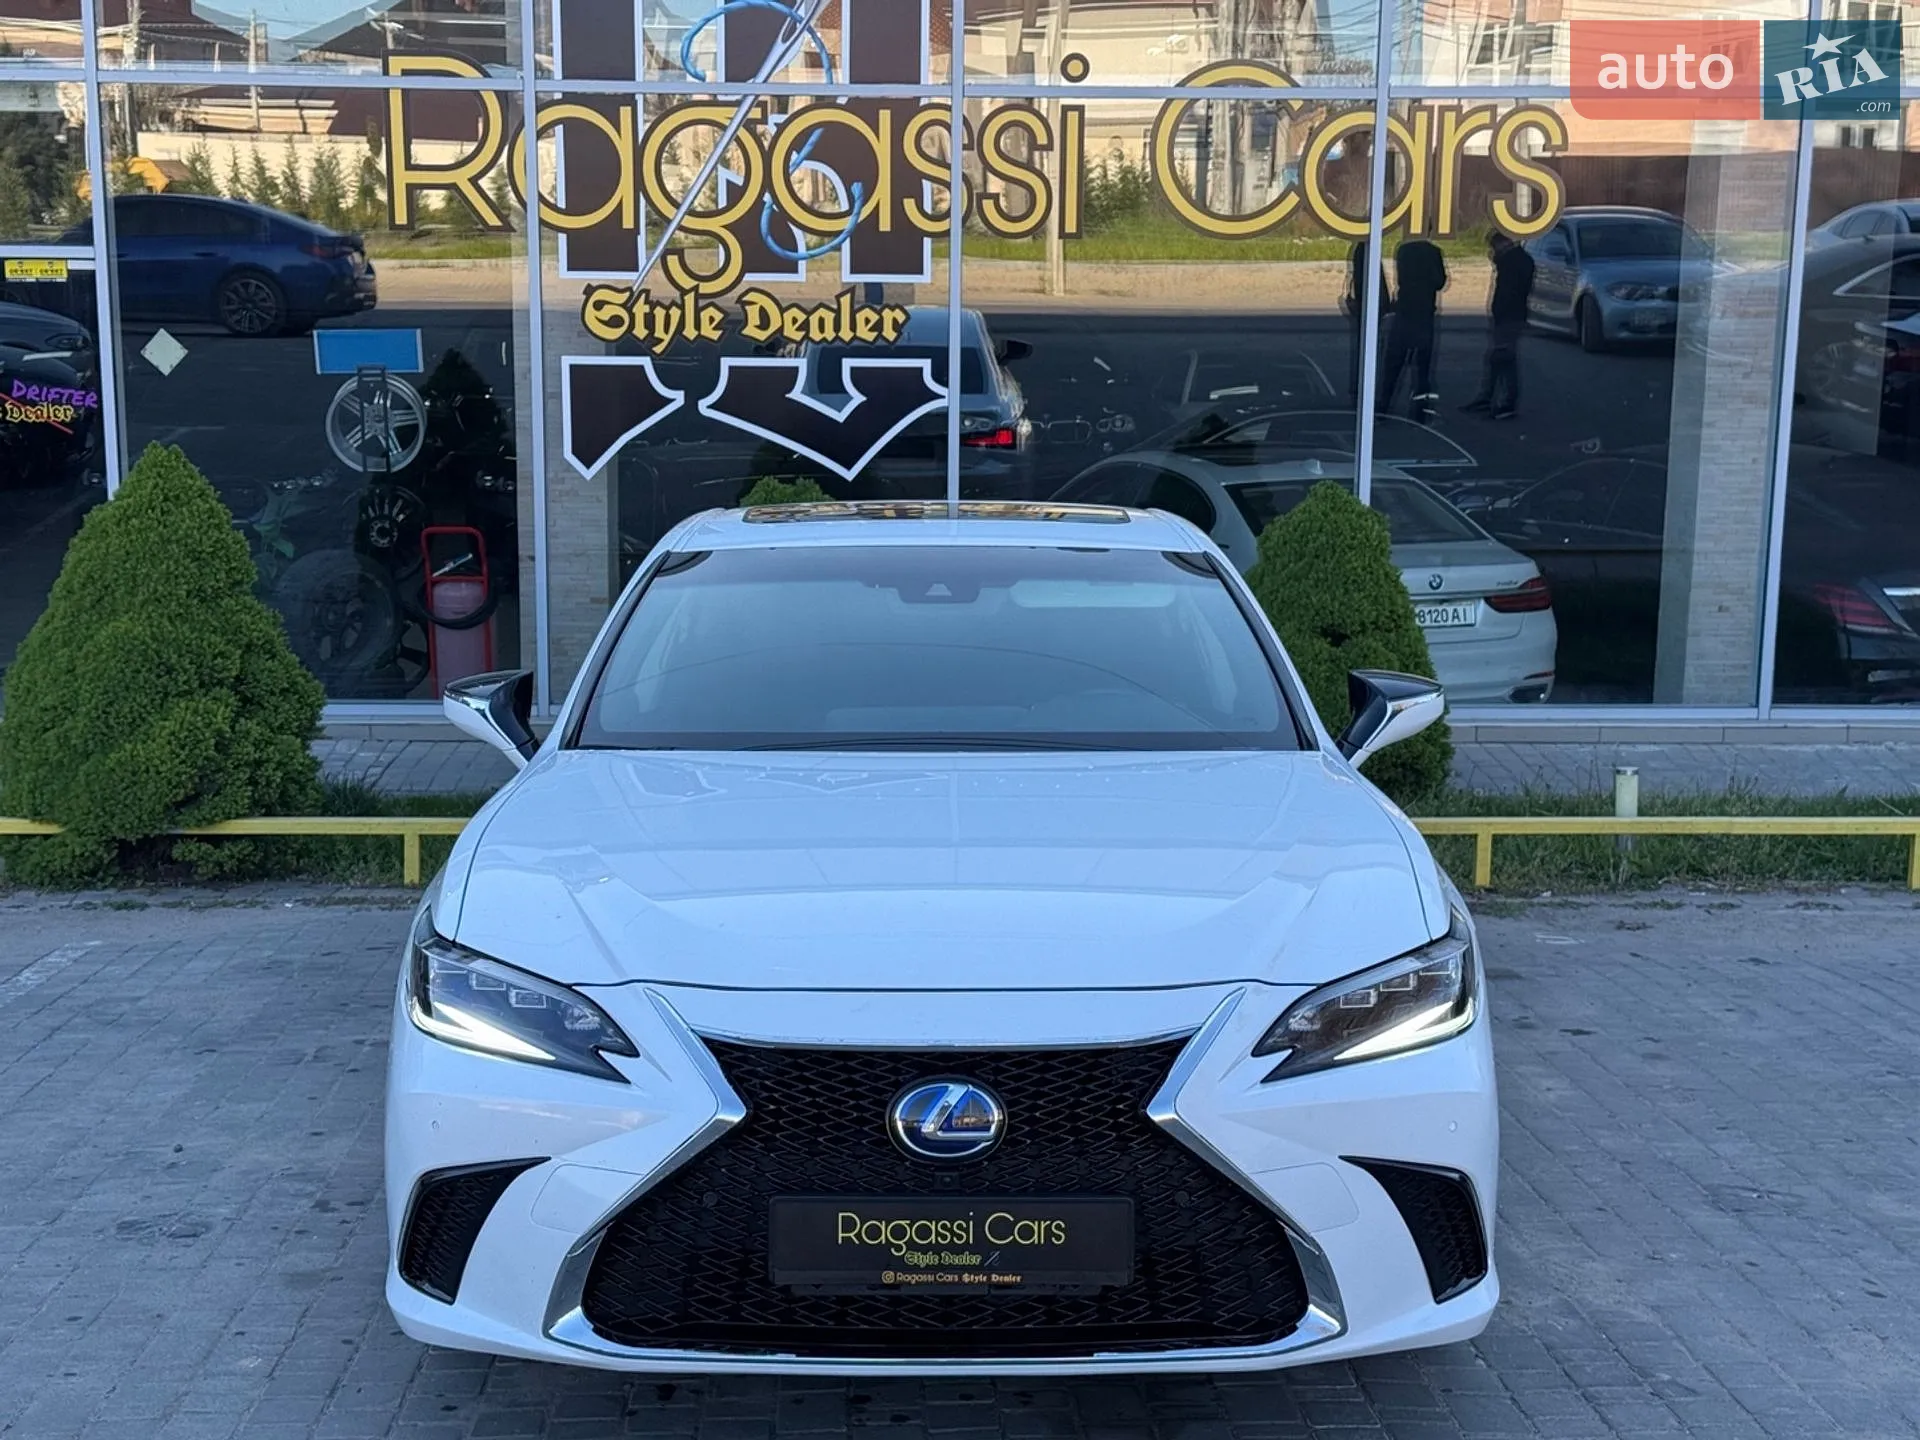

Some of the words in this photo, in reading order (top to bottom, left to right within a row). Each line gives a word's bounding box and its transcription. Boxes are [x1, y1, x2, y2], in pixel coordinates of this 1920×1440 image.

[383, 50, 1087, 296] Ragassi
[1150, 59, 1569, 240] Cars
[583, 283, 728, 355] Style
[735, 286, 911, 344] Dealer
[12, 379, 98, 409] DRIFTER
[5, 401, 74, 423] Dealer
[837, 1211, 974, 1256] Ragassi
[984, 1212, 1067, 1246] Cars
[904, 1251, 939, 1267] Style
[940, 1251, 982, 1265] Dealer
[896, 1272, 935, 1285] Ragassi
[936, 1272, 959, 1283] Cars
